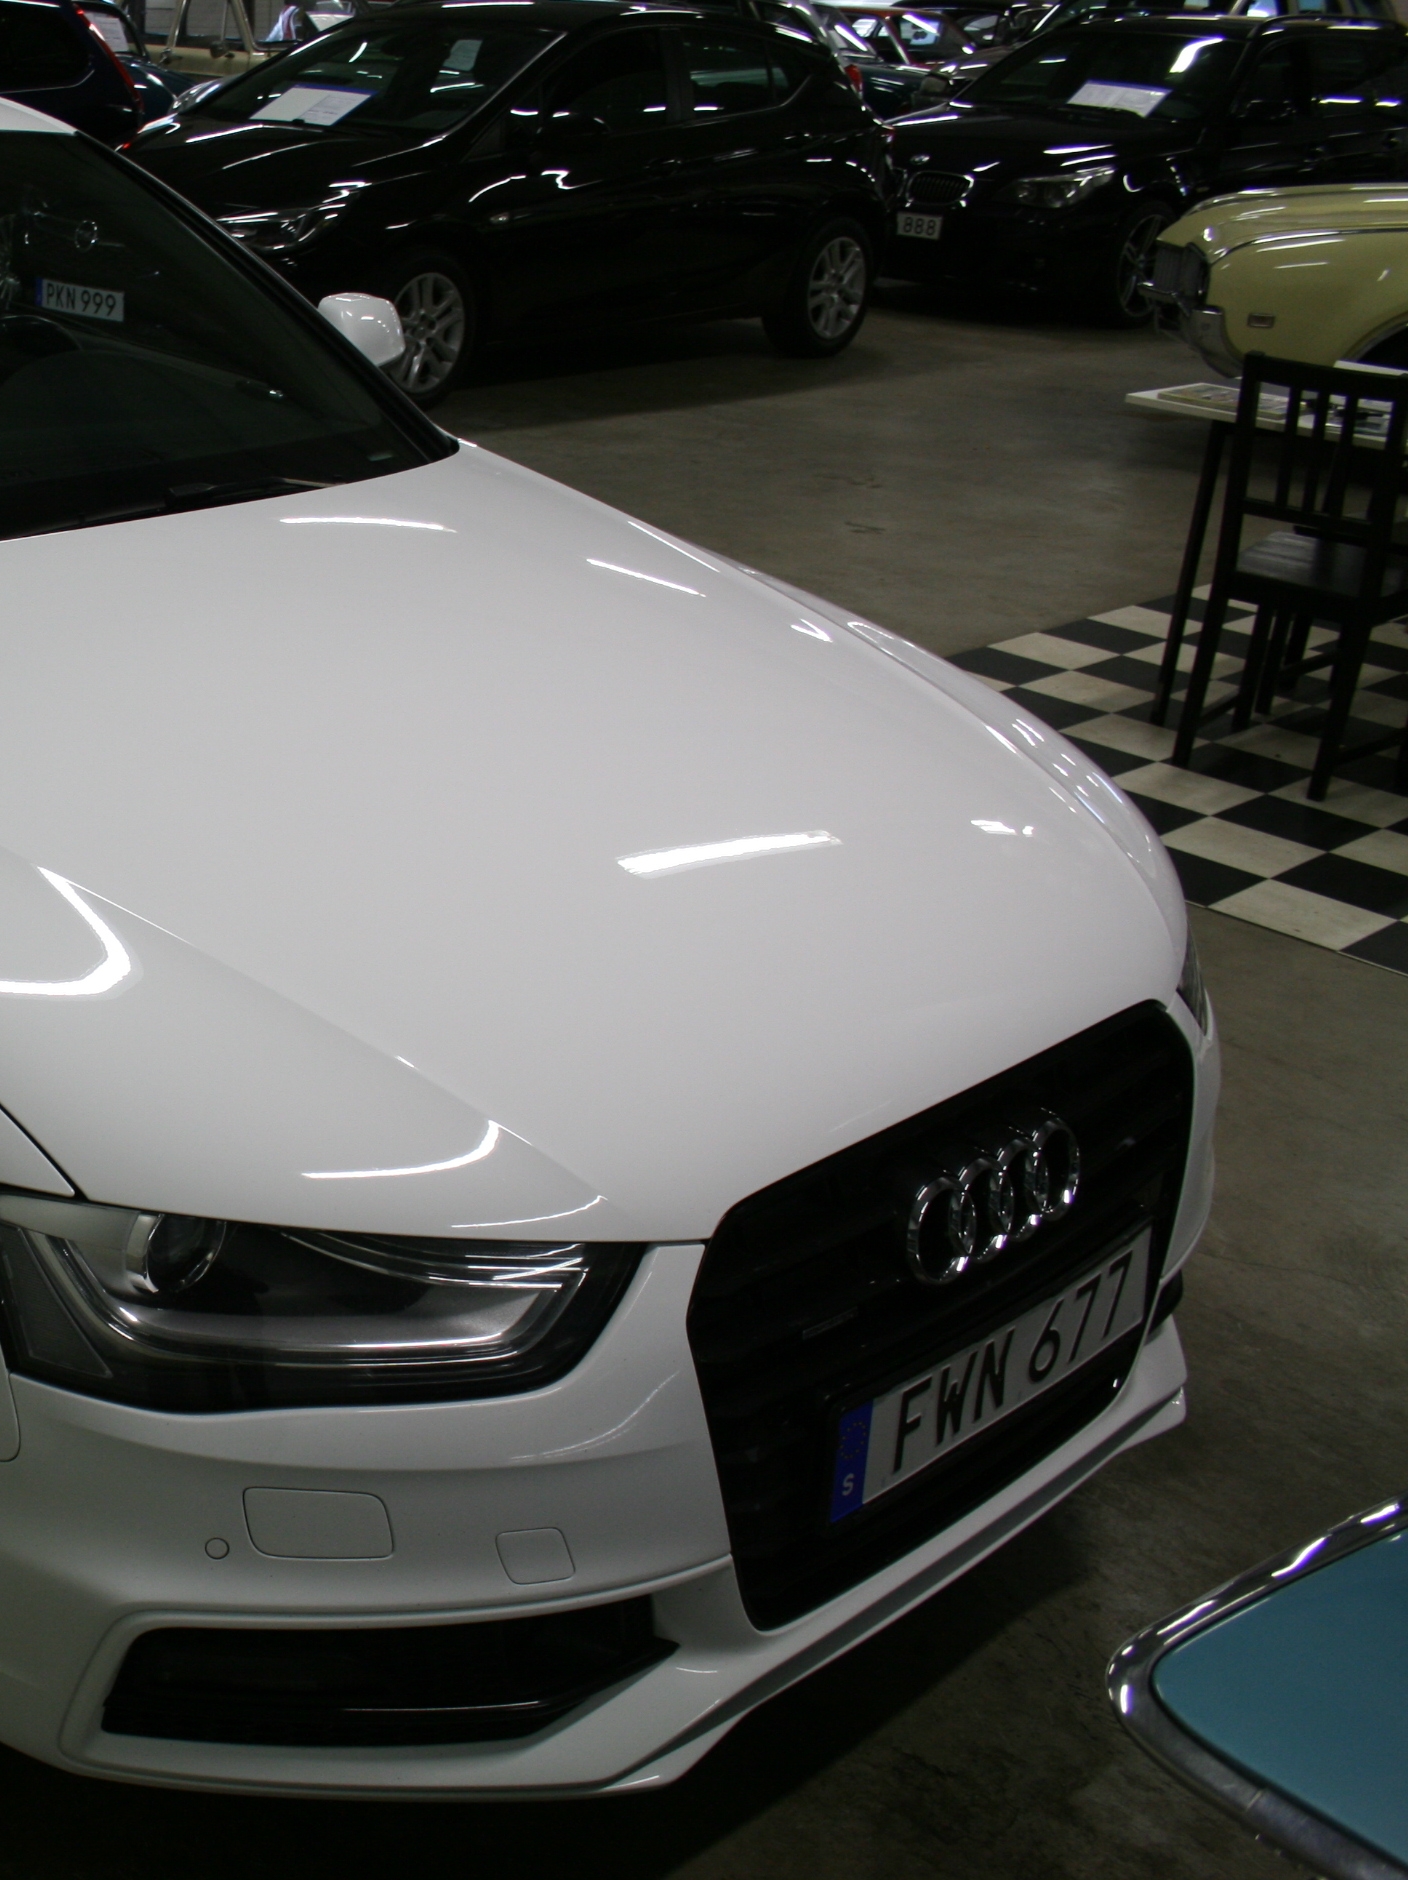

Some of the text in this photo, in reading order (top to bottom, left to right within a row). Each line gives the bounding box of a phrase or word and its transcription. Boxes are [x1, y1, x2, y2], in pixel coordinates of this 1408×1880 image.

[903, 216, 937, 236] 888
[46, 283, 116, 317] PKN 999
[894, 1249, 1133, 1474] FWN 677
[842, 1473, 855, 1497] S
